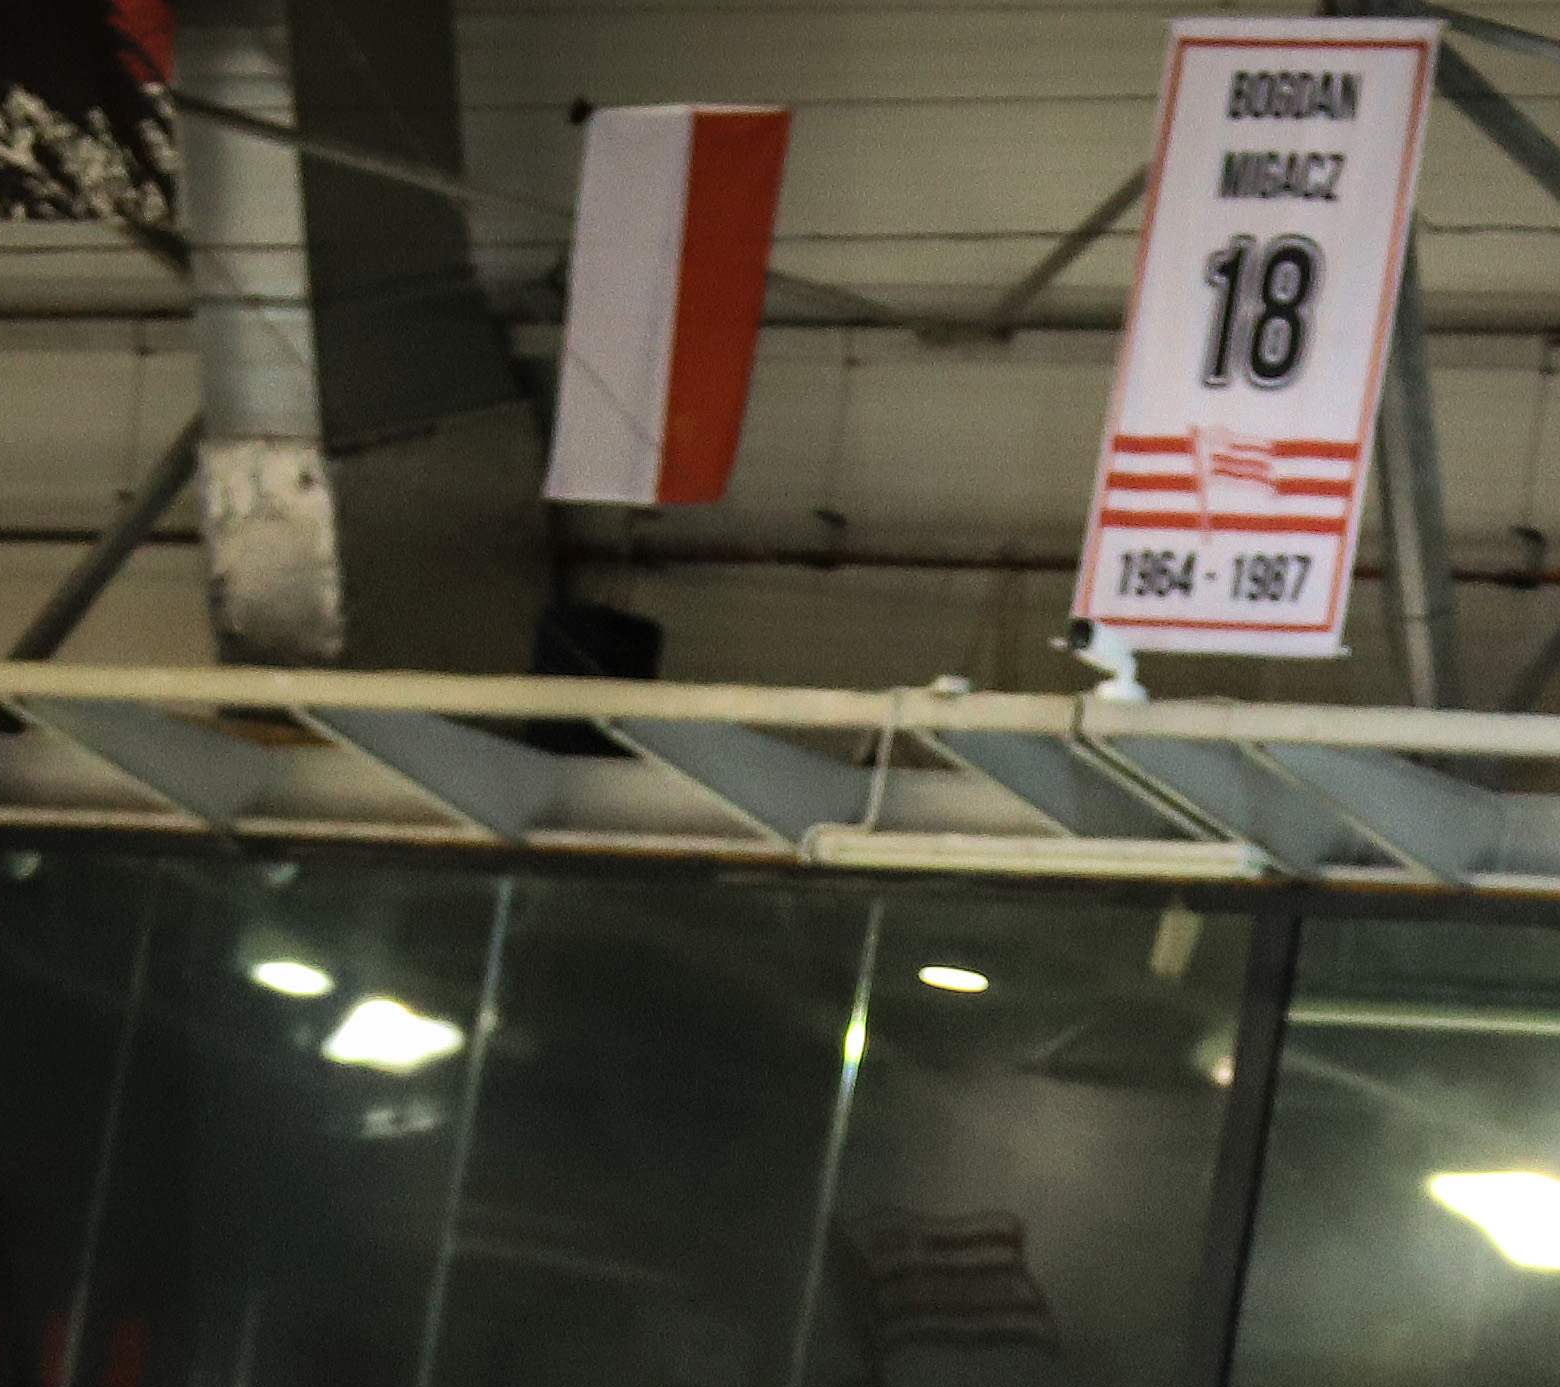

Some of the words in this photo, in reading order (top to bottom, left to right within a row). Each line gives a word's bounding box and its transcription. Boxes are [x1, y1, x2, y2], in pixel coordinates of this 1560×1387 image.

[1227, 70, 1360, 120] BOGDAN
[1201, 234, 1324, 388] 18
[1117, 551, 1198, 598] 1964
[1229, 553, 1313, 602] 1987
